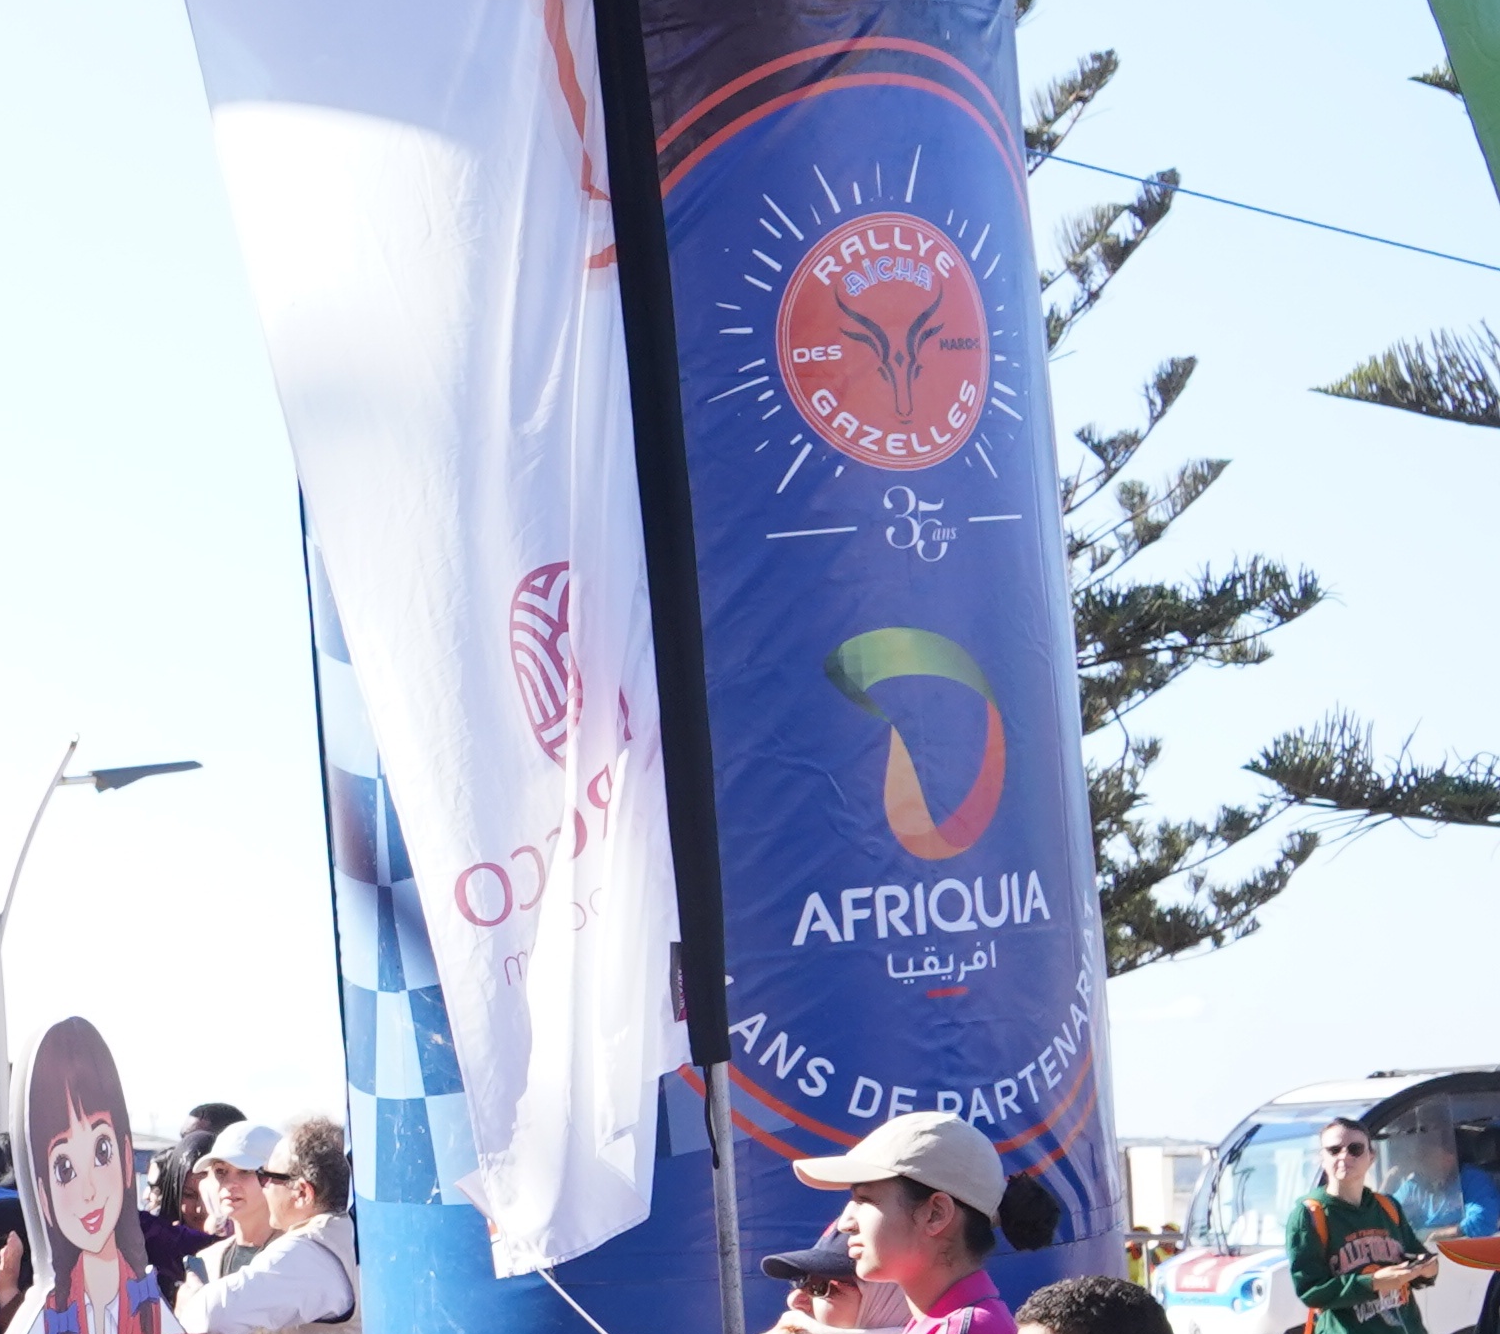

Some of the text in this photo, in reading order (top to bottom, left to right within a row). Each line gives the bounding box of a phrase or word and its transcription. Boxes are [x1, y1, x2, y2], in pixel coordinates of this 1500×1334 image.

[812, 227, 955, 286] RALLYE
[793, 345, 842, 363] DES
[811, 379, 977, 456] GAZELLES
[792, 869, 1051, 946] AFRIQUIA
